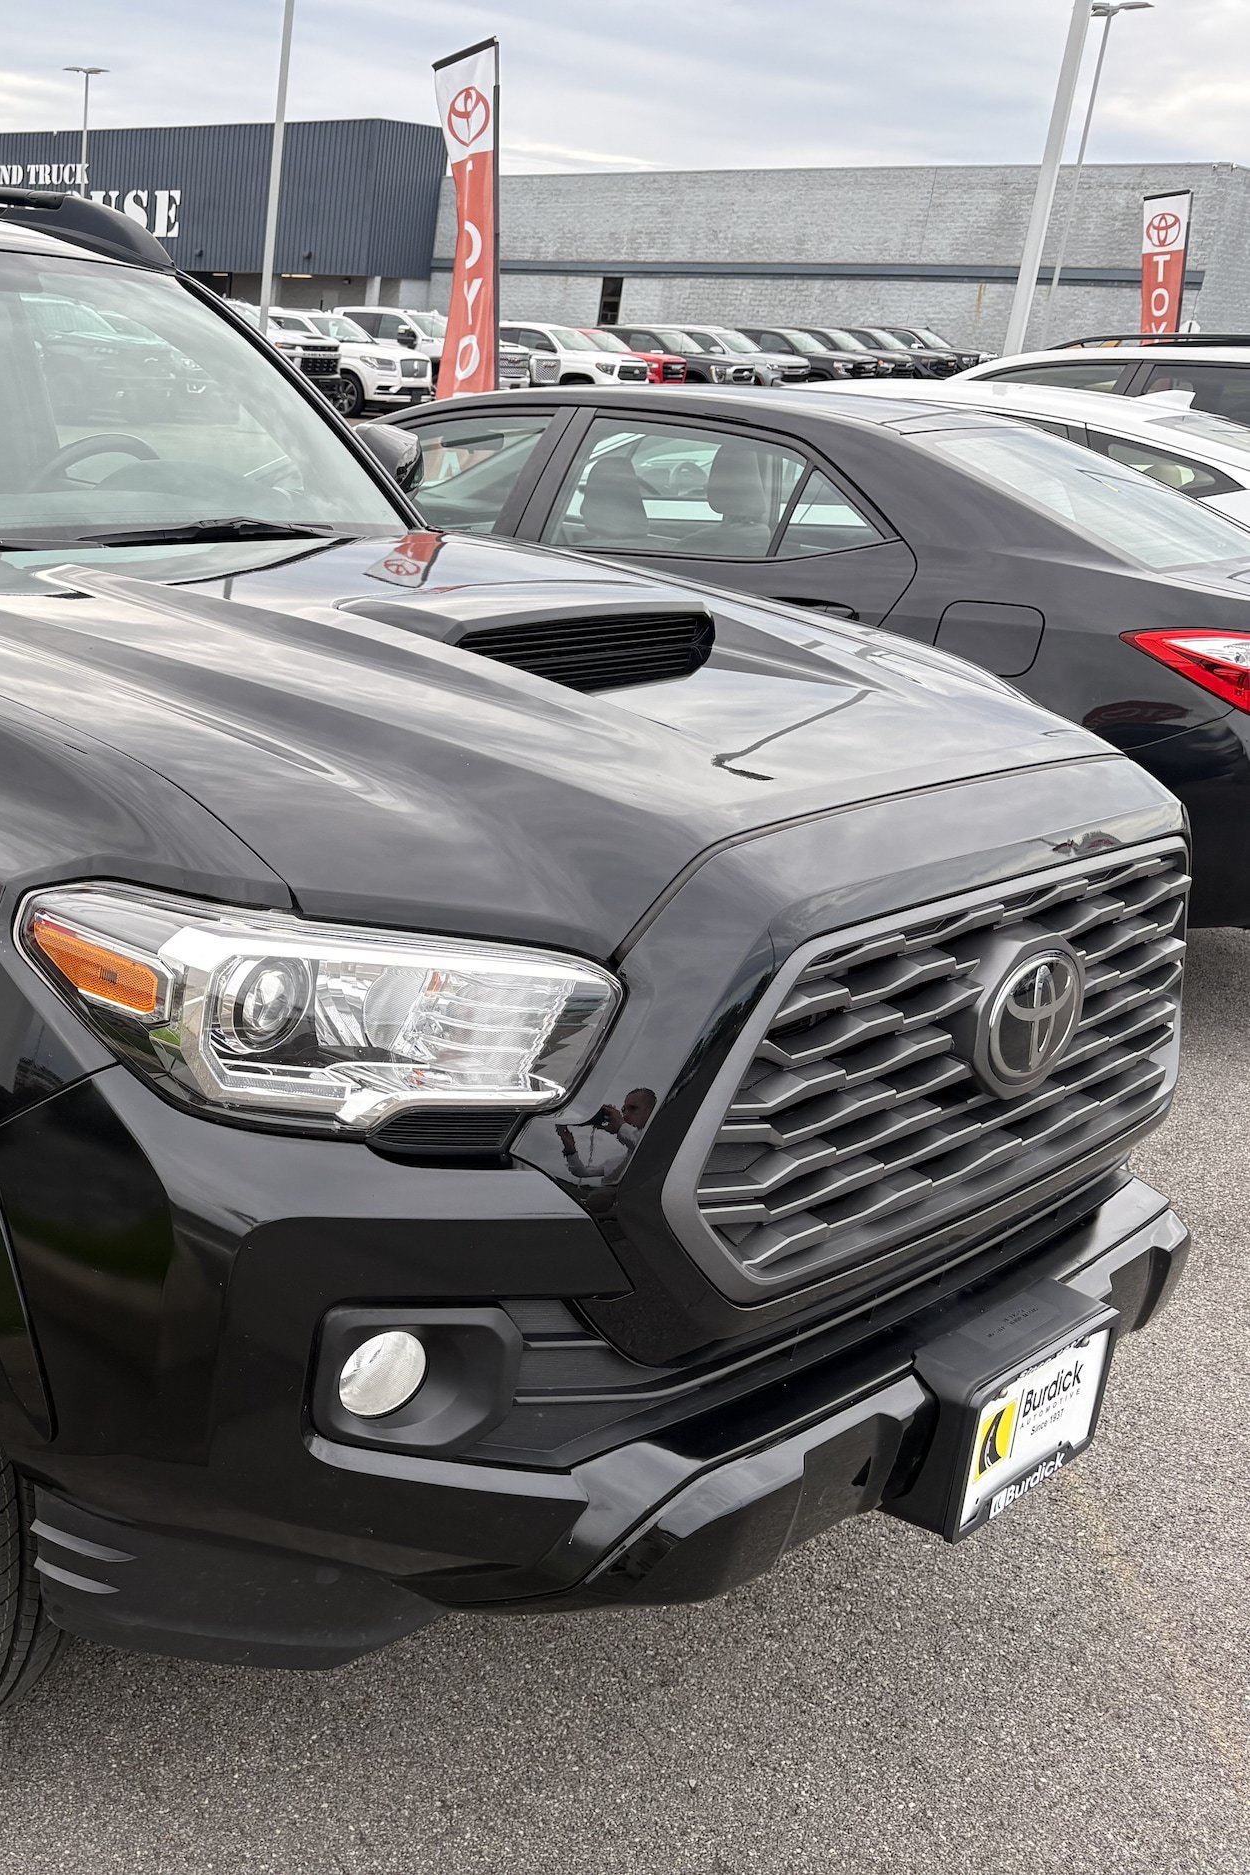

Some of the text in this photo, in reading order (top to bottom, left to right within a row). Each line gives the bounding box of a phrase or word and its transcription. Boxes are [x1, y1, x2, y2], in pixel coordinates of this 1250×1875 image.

[27, 164, 89, 185] TRUCK
[1020, 1388, 1081, 1429] AUTOMOTIVE
[1022, 1360, 1084, 1418] Burdick
[1031, 1419, 1048, 1435] Since
[1005, 1452, 1065, 1507] Burdick
